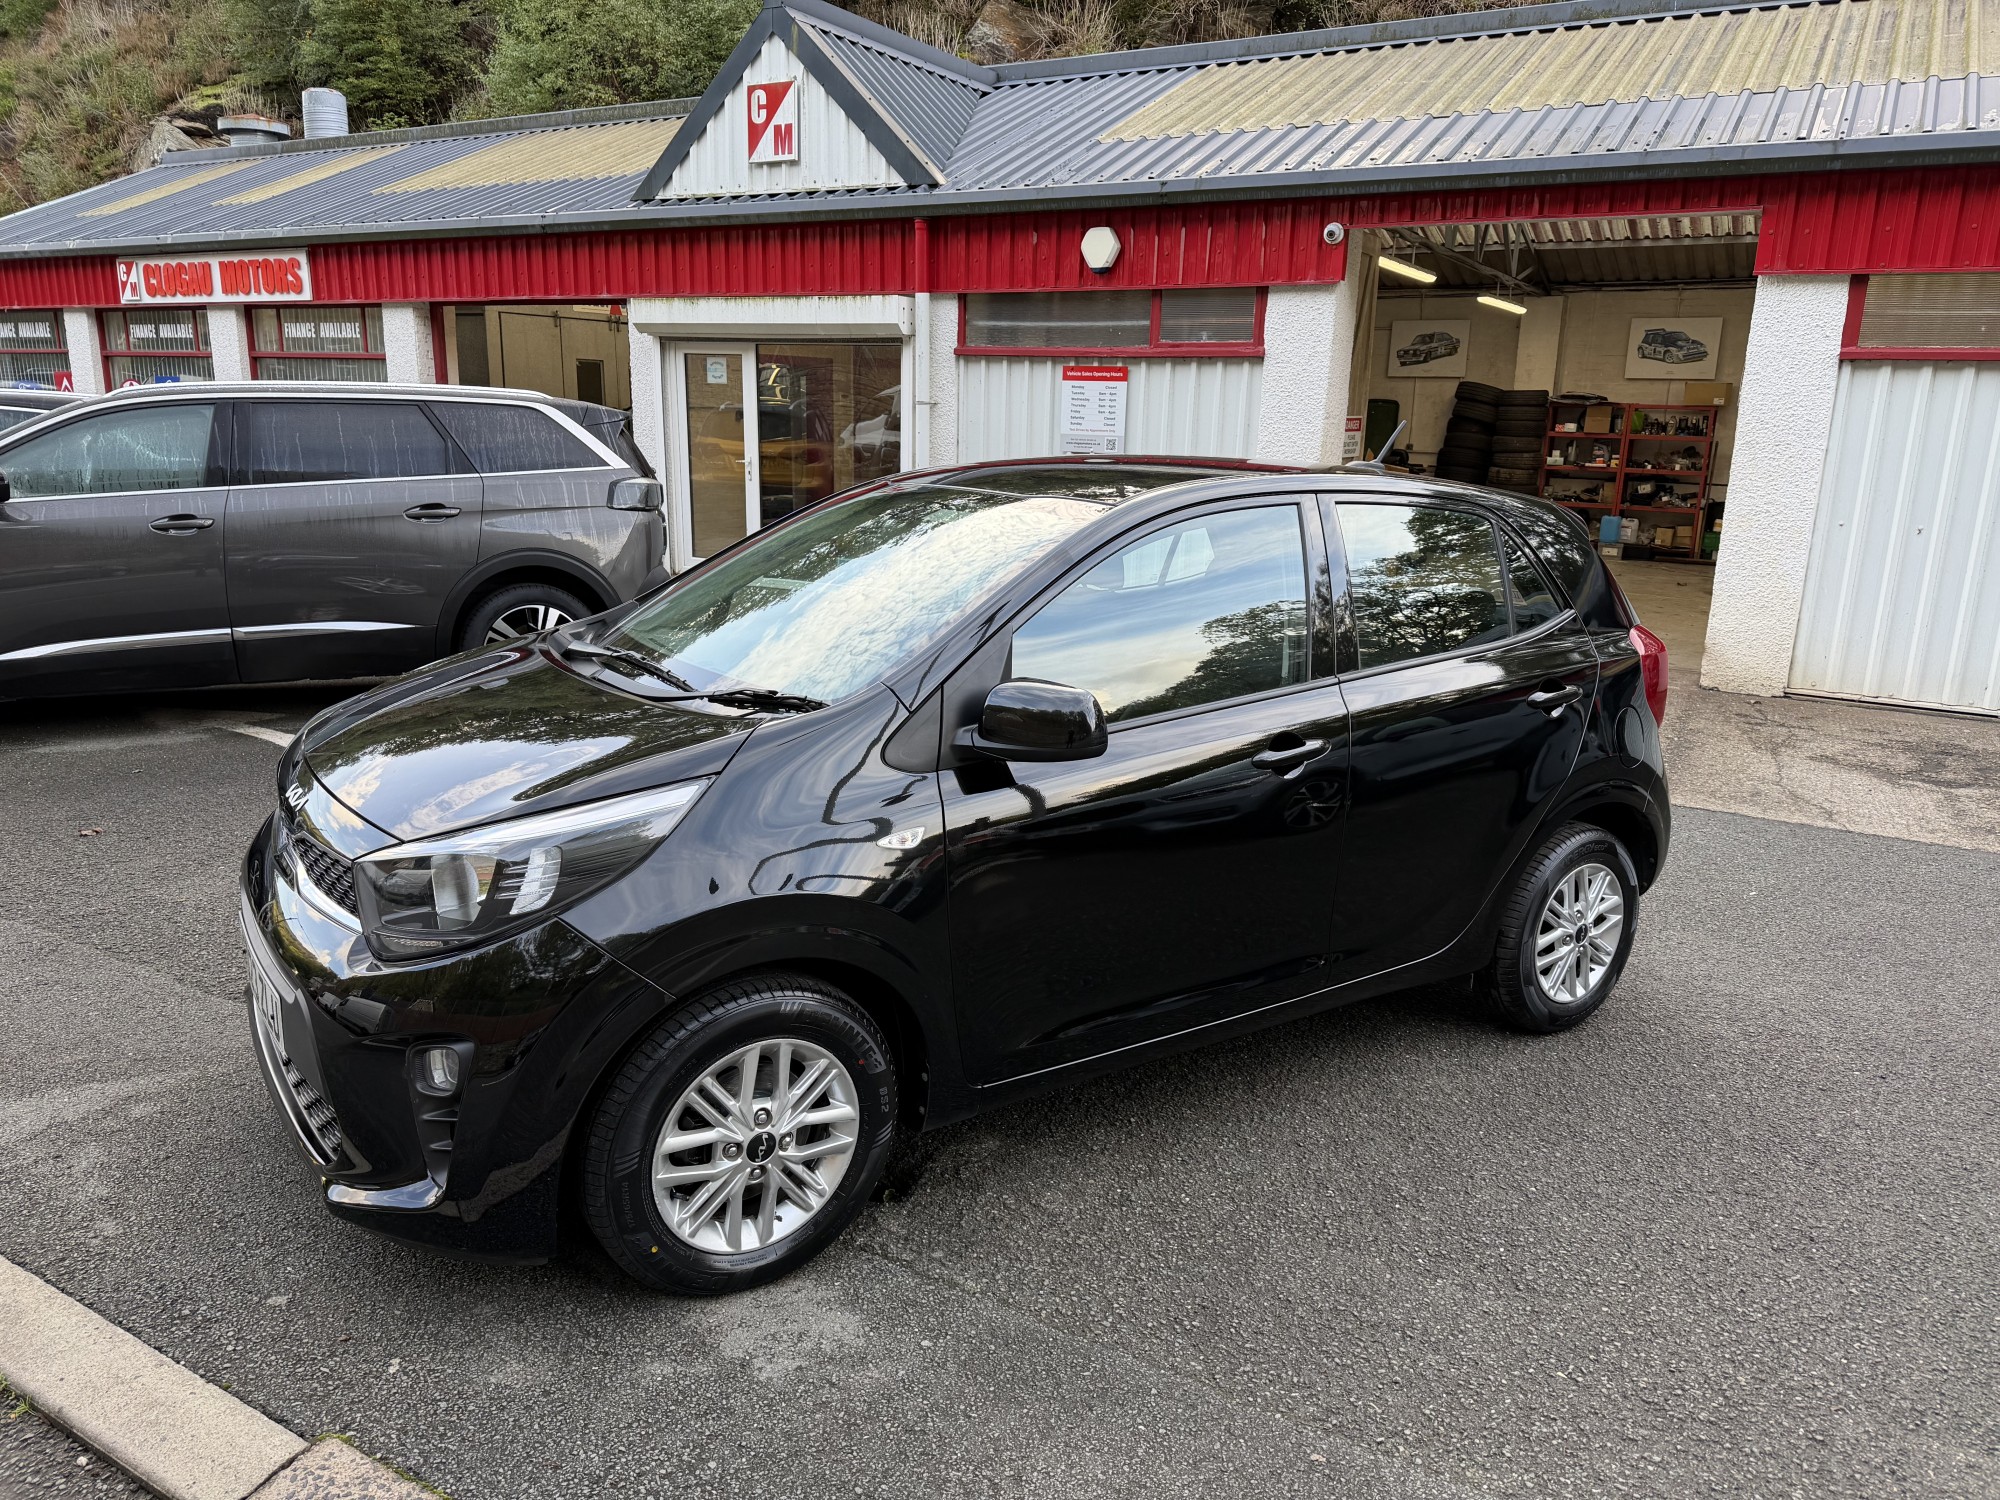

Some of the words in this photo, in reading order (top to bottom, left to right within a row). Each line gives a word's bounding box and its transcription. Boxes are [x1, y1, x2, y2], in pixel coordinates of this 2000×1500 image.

[142, 261, 213, 298] CLOGAU
[218, 257, 303, 295] MOTORS
[0, 322, 16, 337] ANCE
[18, 322, 51, 337] AVAILABLE
[130, 324, 156, 338] FINANCE
[159, 324, 193, 338] AVAILABLE
[284, 322, 316, 338] FINANCE
[320, 322, 360, 338] AVAILABLE
